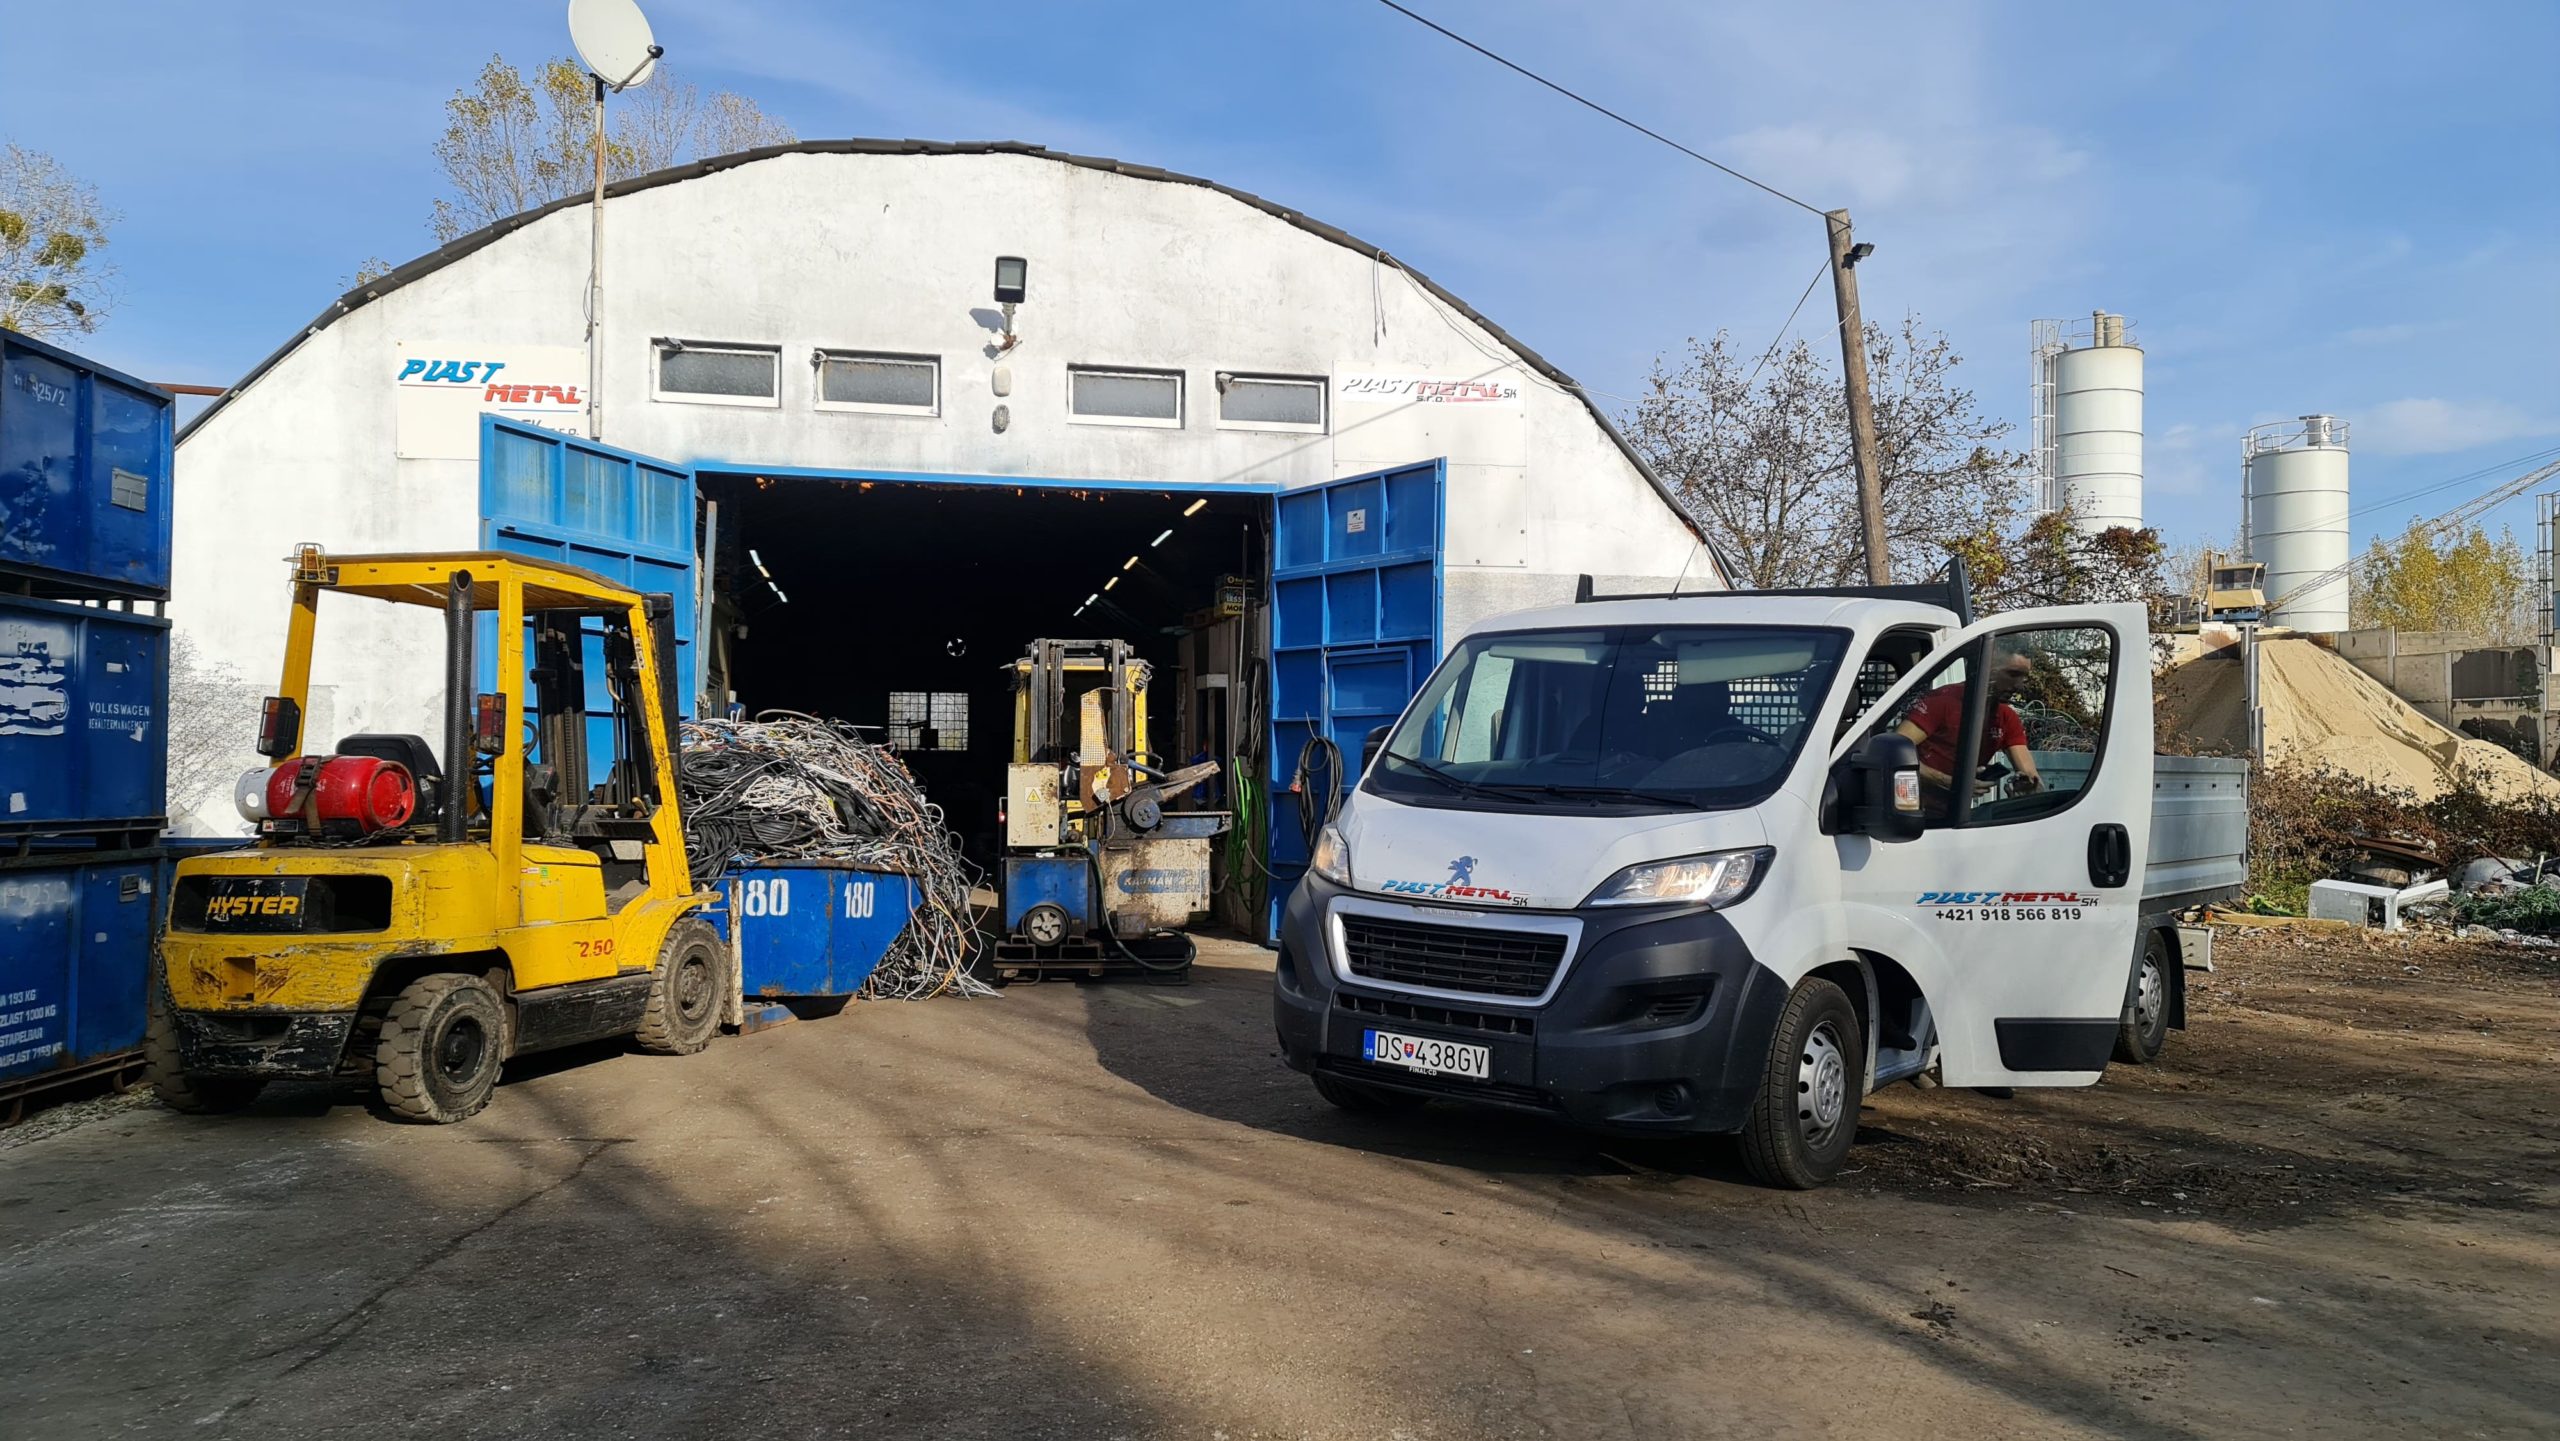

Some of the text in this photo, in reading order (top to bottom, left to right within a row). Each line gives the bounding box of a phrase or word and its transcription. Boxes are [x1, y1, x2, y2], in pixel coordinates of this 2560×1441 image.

[398, 359, 505, 383] PLAST
[484, 384, 583, 405] METAL
[1416, 380, 1503, 398] METAL
[1503, 388, 1517, 399] SK
[1416, 395, 1445, 403] s.r.o.
[89, 701, 150, 717] VOLKSWAGEN
[844, 882, 874, 918] 180
[1381, 879, 1529, 907] PLAST METAL SK
[1916, 892, 2099, 907] PLAST METAL SK
[207, 896, 299, 915] HYSTER
[1936, 908, 2082, 921] +421 918 566 819
[25, 988, 37, 1002] KG
[45, 1004, 56, 1018] KG
[1377, 1034, 1486, 1075] DS 438GV
